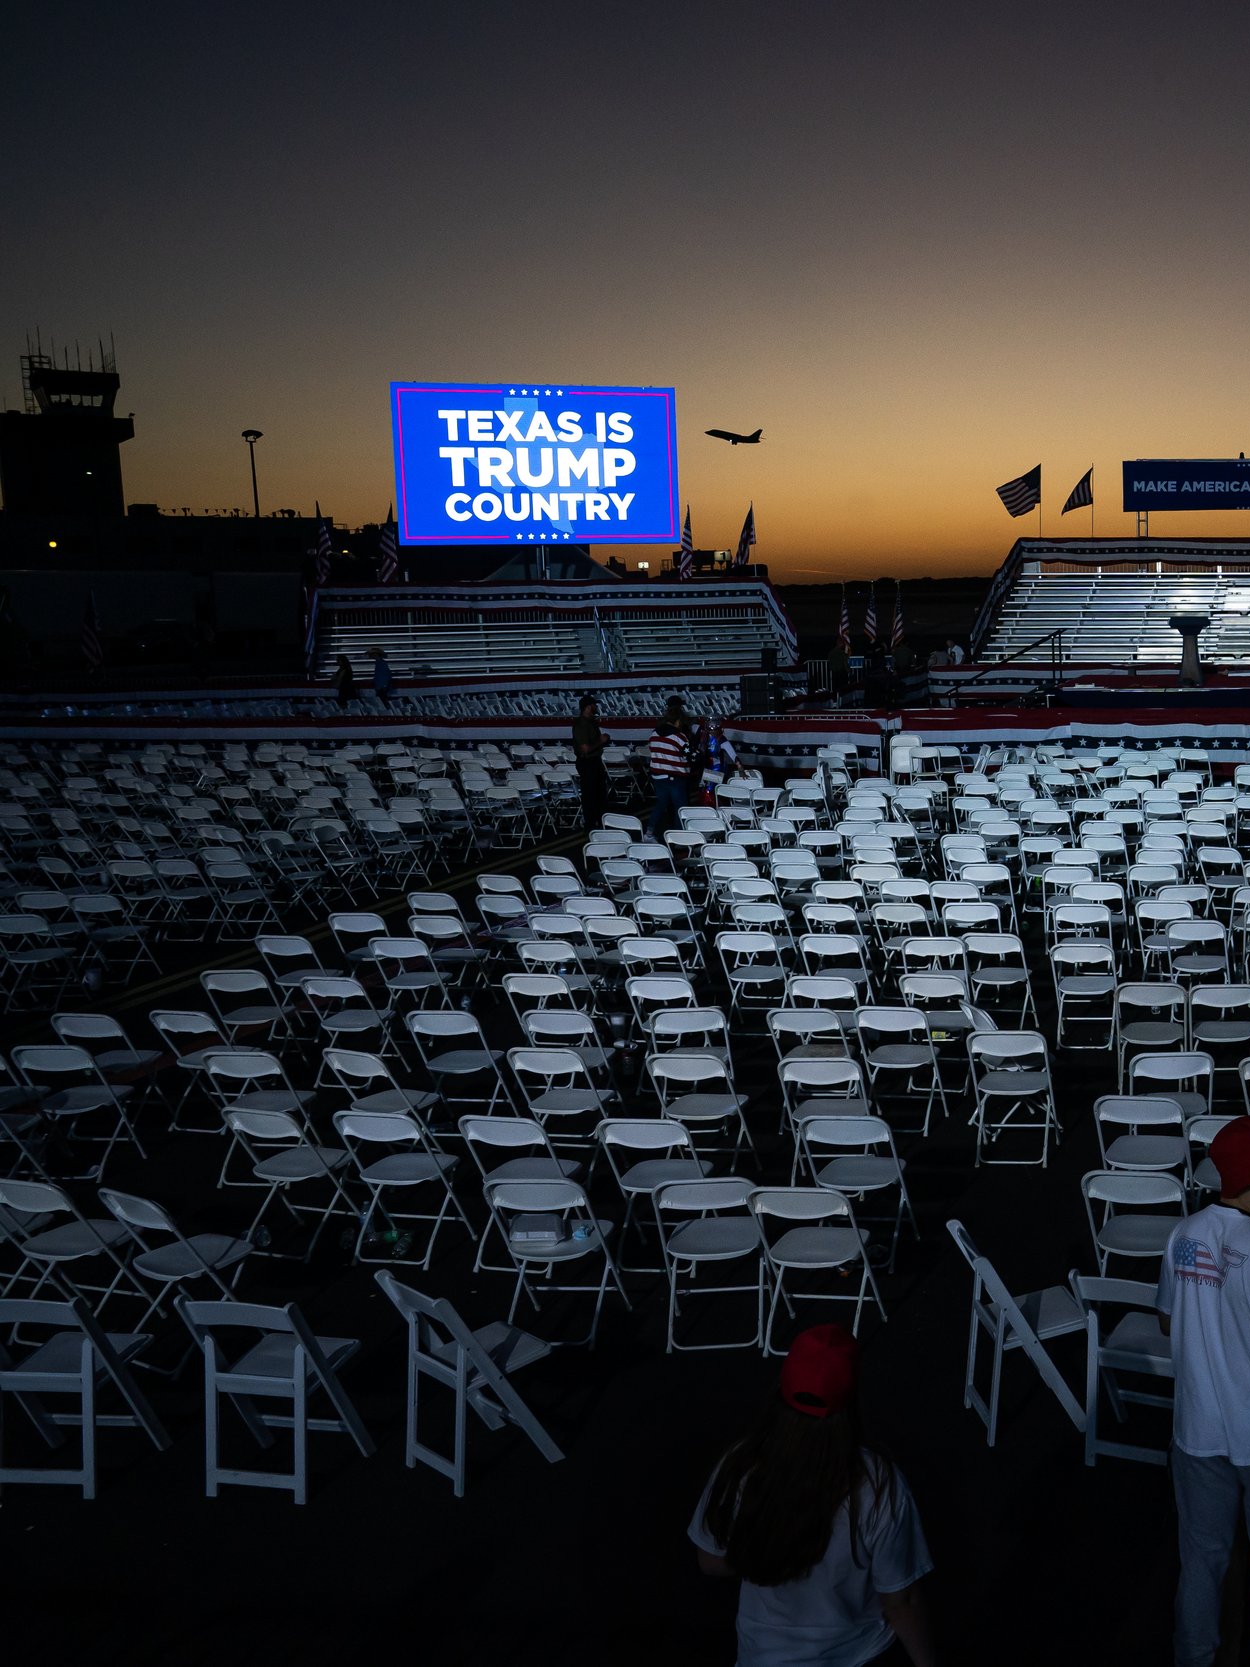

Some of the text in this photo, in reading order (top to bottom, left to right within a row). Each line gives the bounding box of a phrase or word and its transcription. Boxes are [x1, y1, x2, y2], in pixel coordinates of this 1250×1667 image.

[438, 409, 634, 444] TEXAS IS
[439, 446, 636, 488] TRUMP
[1133, 480, 1177, 492] MAKE
[445, 492, 636, 522] COUNTRY
